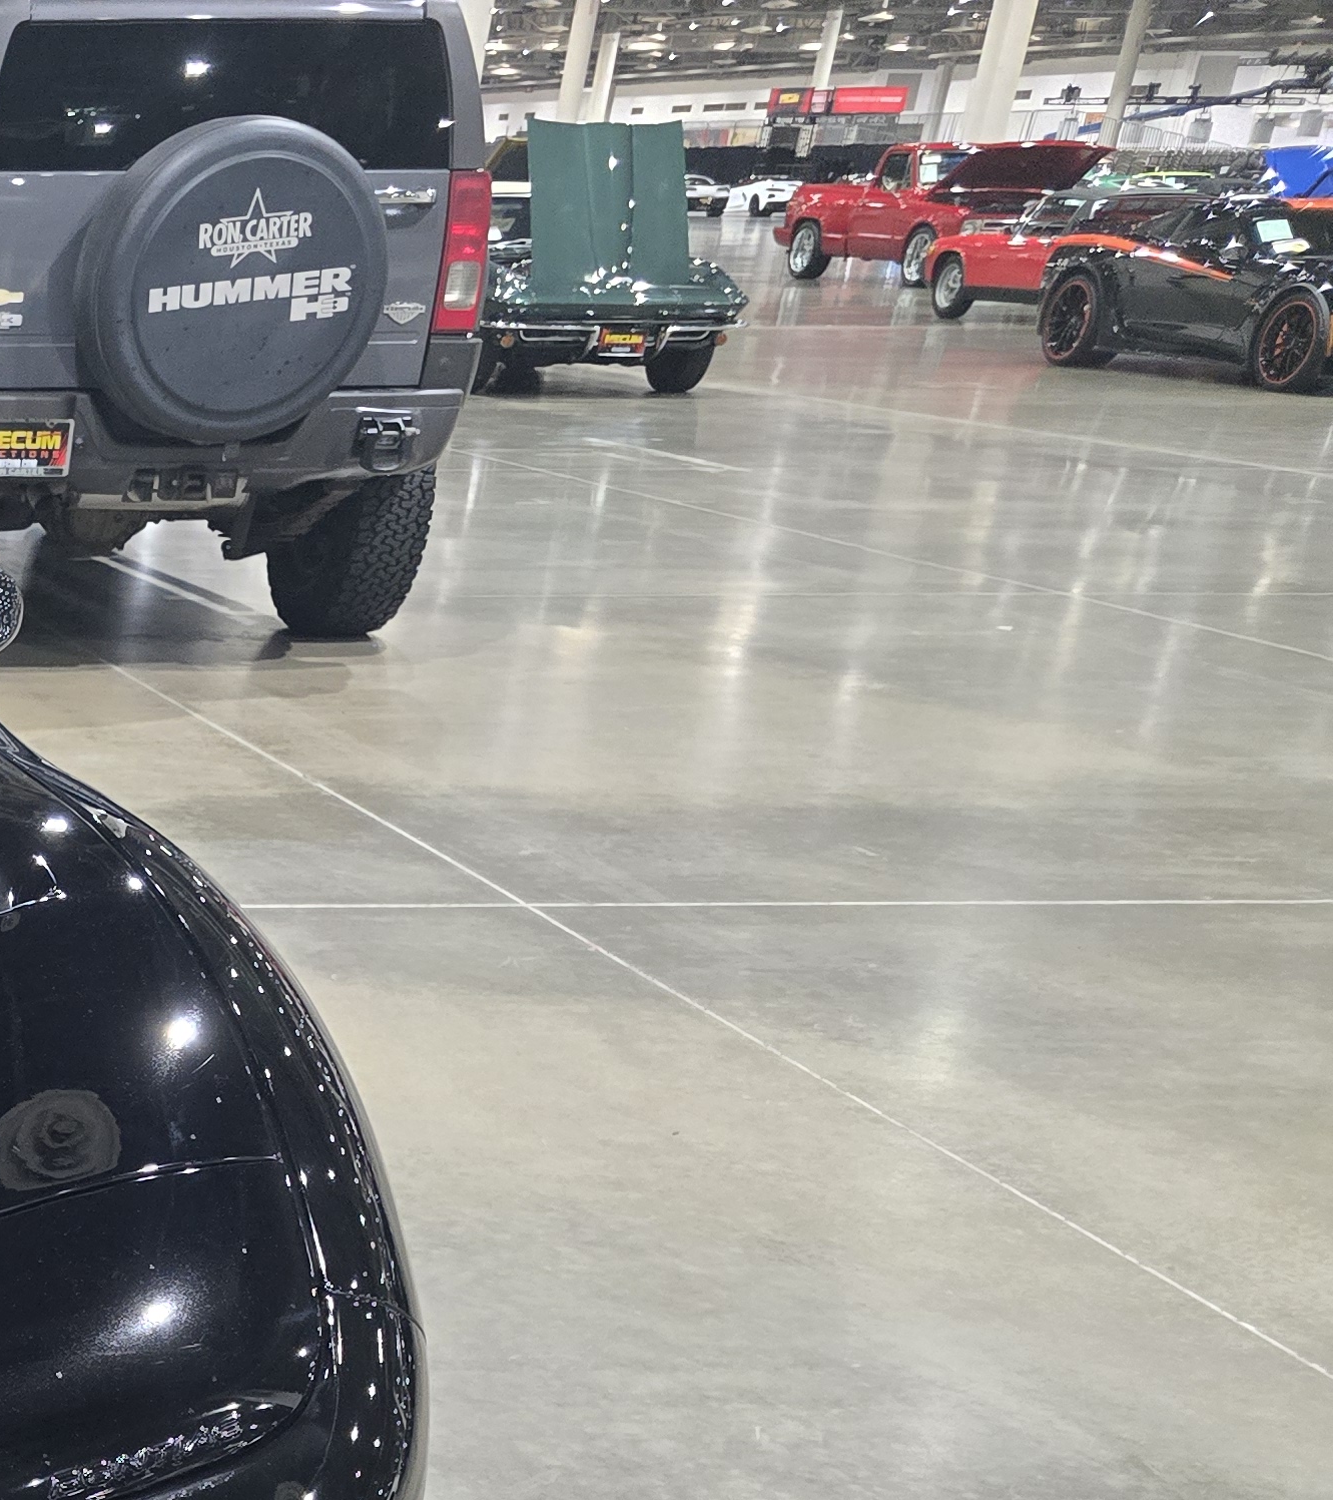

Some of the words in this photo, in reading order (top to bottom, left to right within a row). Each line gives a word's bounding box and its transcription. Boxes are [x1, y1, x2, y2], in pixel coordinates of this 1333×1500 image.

[199, 221, 242, 249] RON
[245, 211, 312, 242] CARTER
[148, 266, 353, 314] HUMMER
[290, 293, 350, 322] H3
